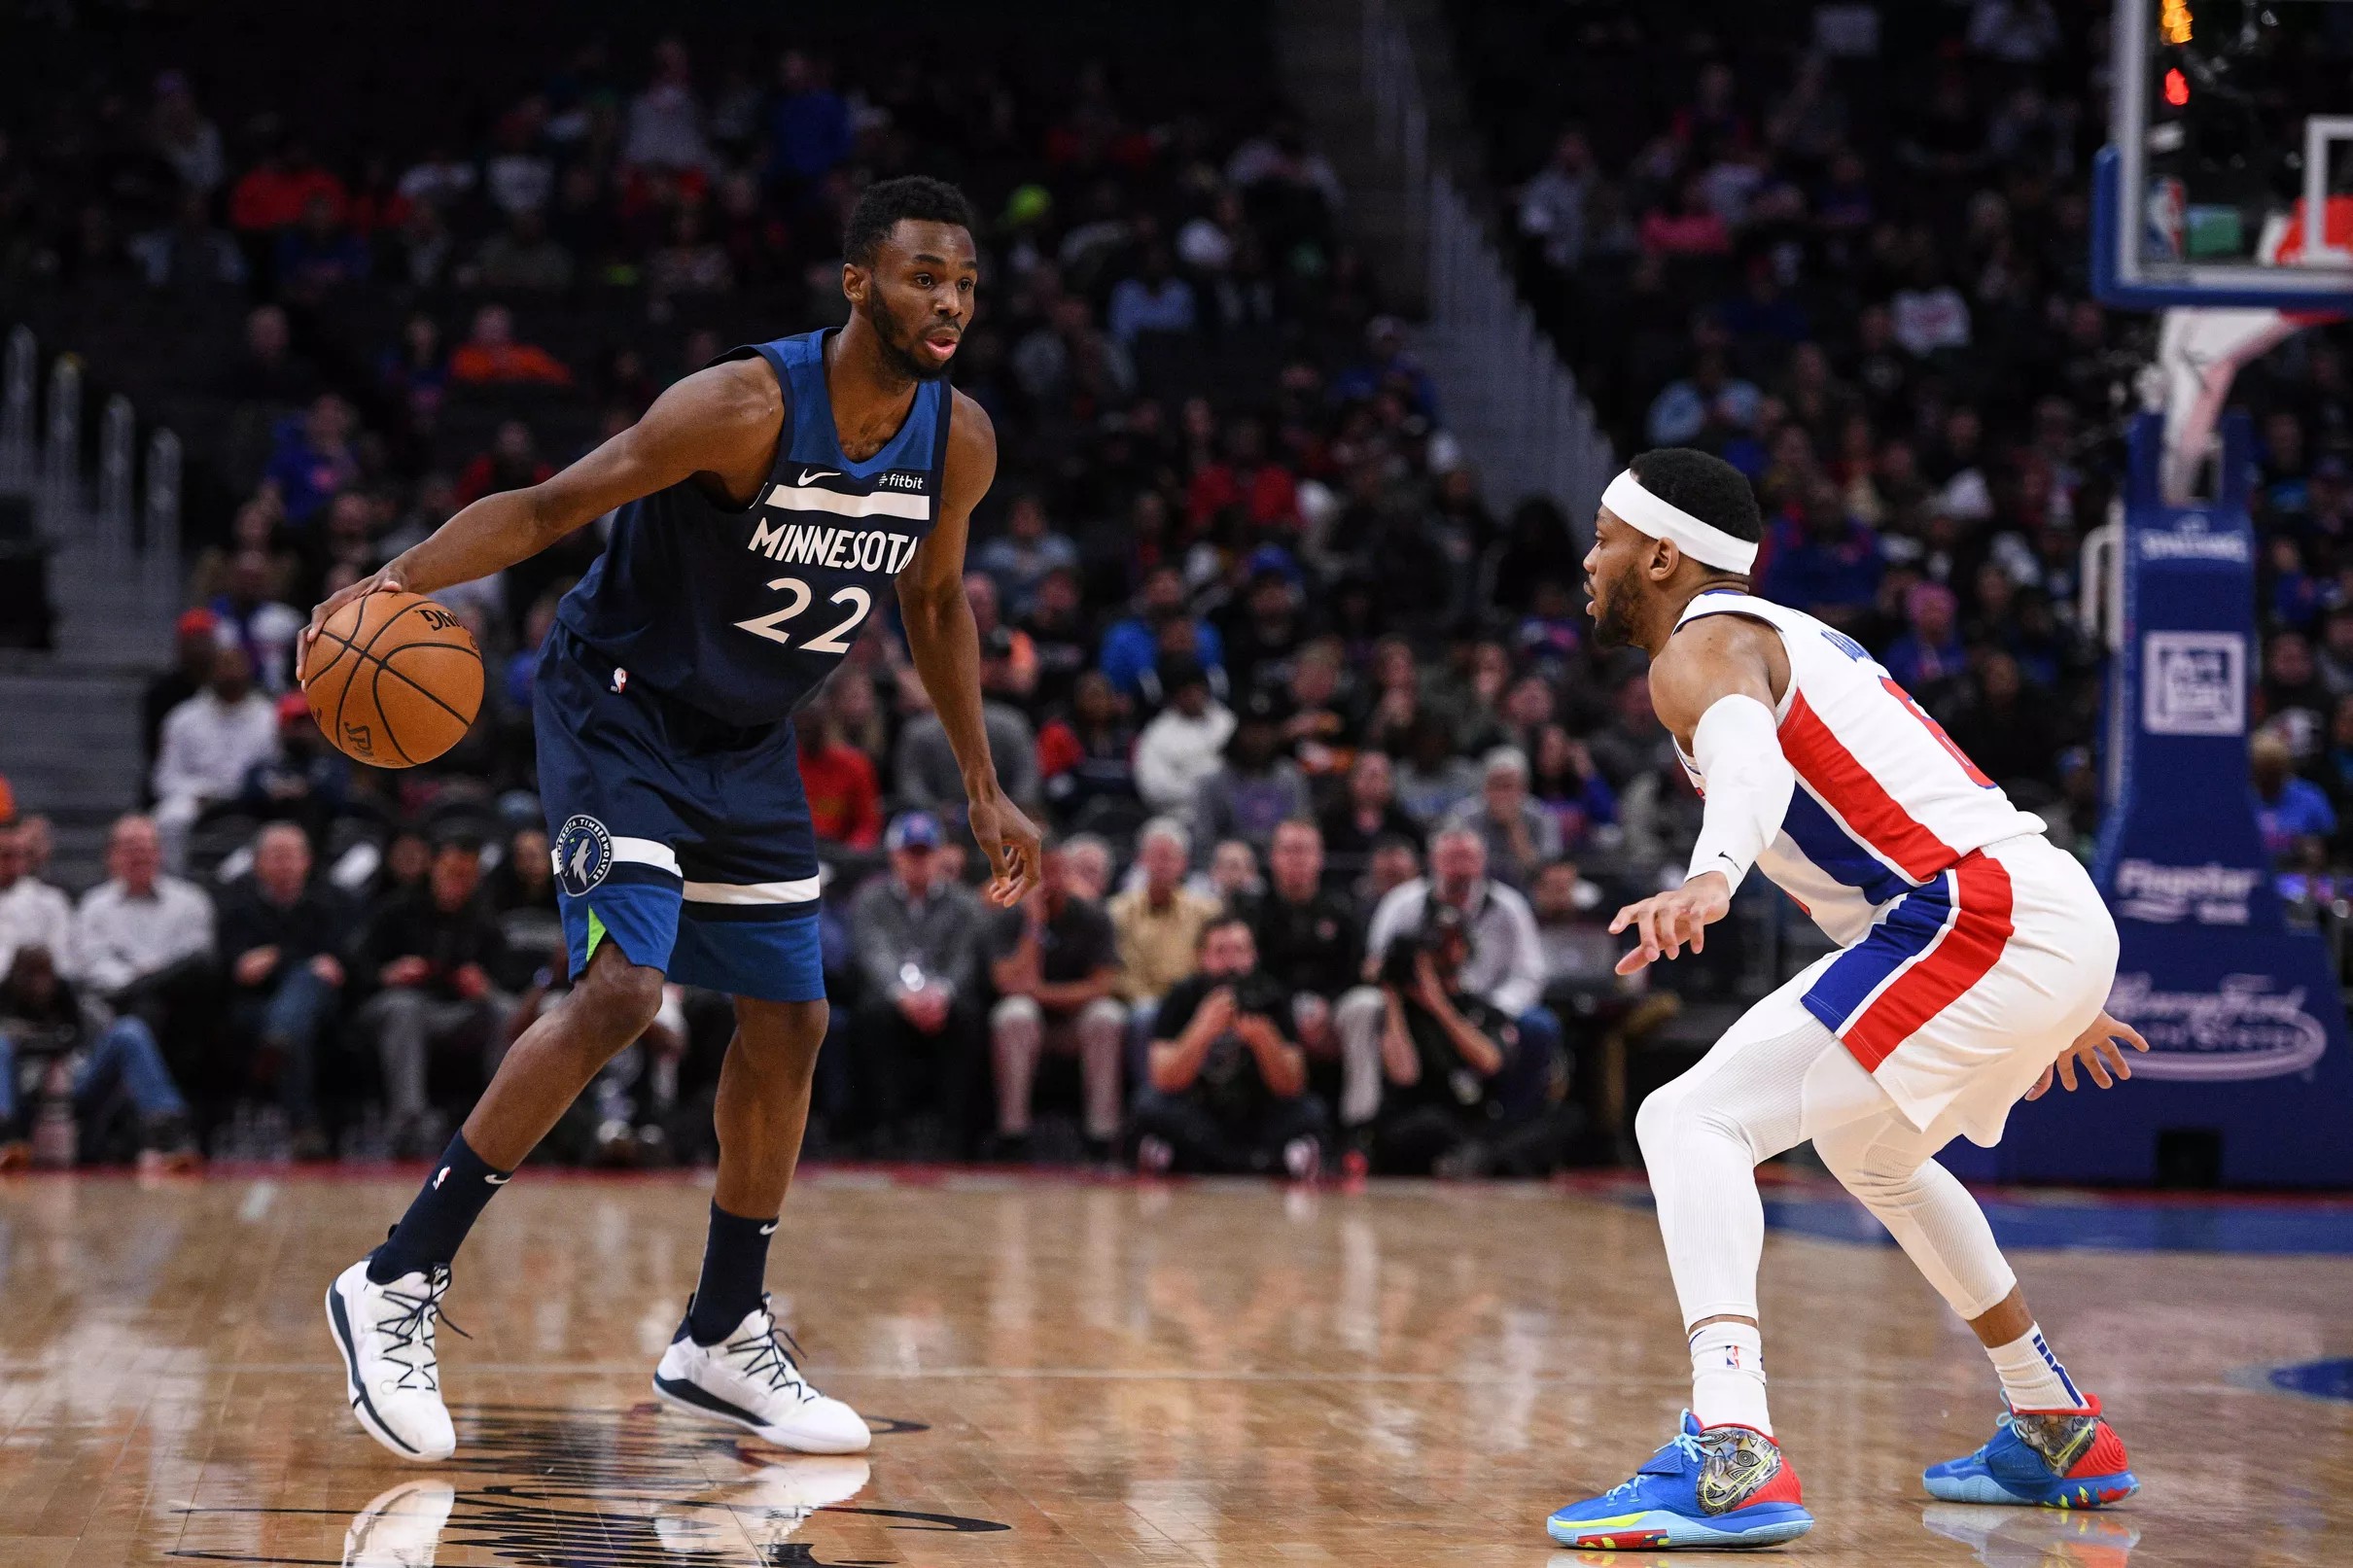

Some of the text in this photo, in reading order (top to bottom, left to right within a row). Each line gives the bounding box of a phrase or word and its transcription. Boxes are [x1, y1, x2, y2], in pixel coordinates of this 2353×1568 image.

[889, 473, 924, 490] fitbit
[733, 577, 871, 654] 22
[579, 819, 611, 881] TIMBERWOLVES
